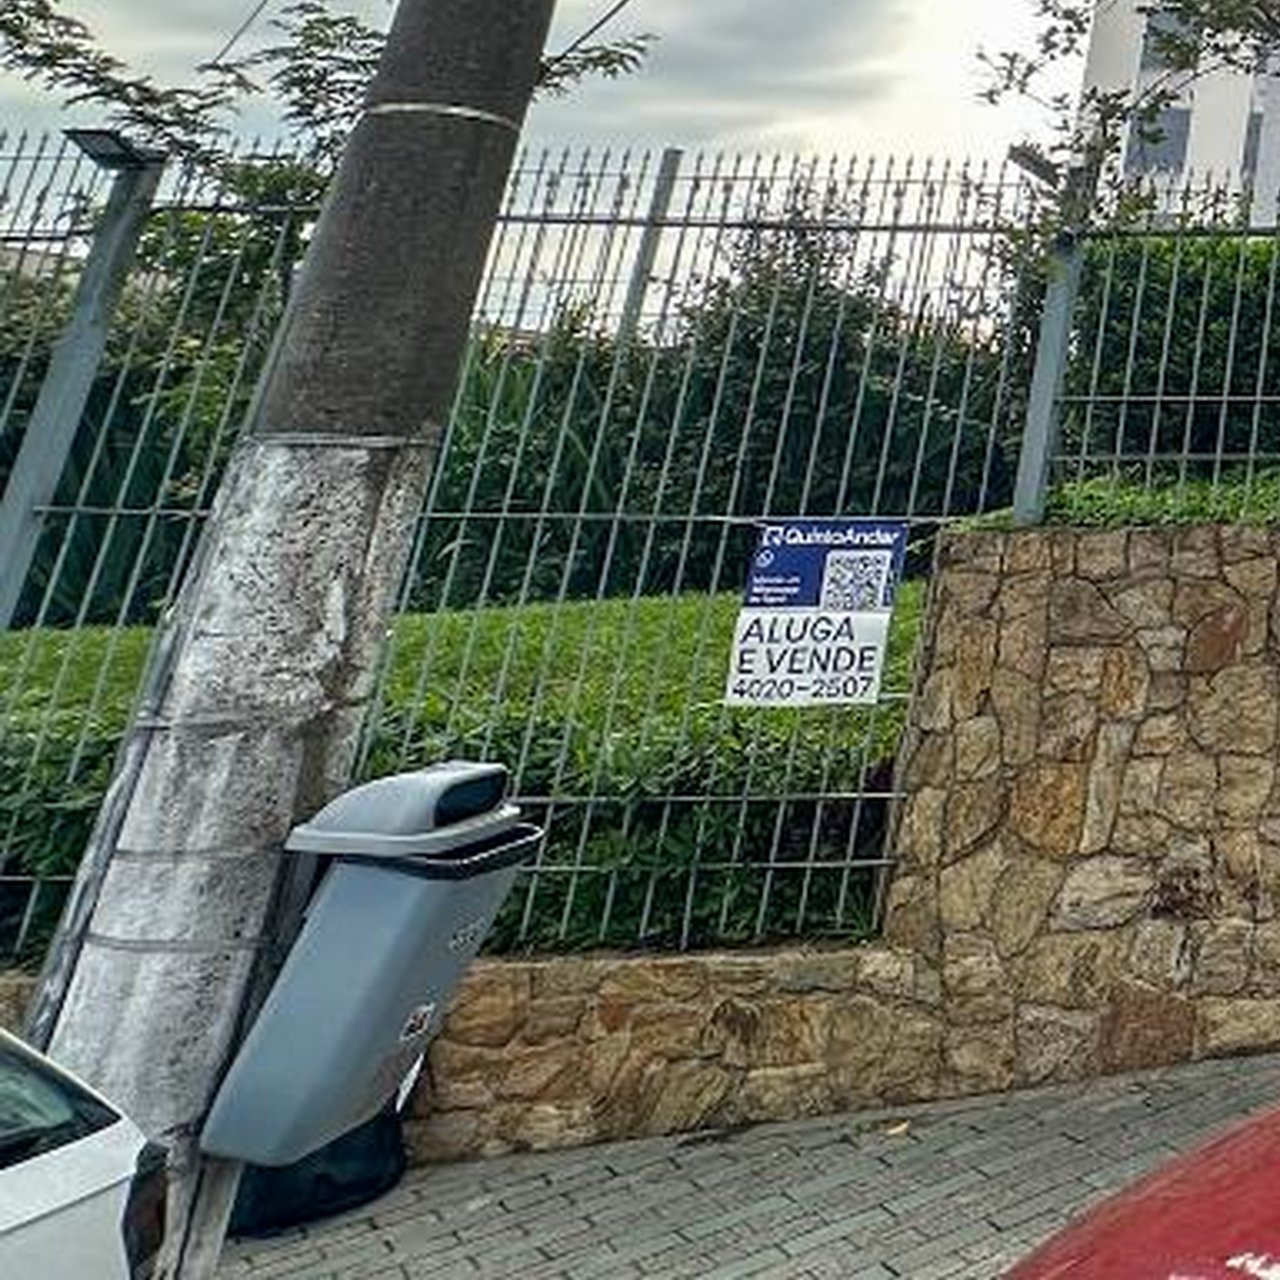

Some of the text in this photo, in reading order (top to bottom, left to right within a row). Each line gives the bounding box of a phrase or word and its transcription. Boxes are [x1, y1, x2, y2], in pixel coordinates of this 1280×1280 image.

[785, 526, 899, 545] QuintoAndar
[740, 617, 854, 643] ALUGA
[737, 647, 877, 673] E VENDE
[733, 678, 873, 699] 4020-2507
